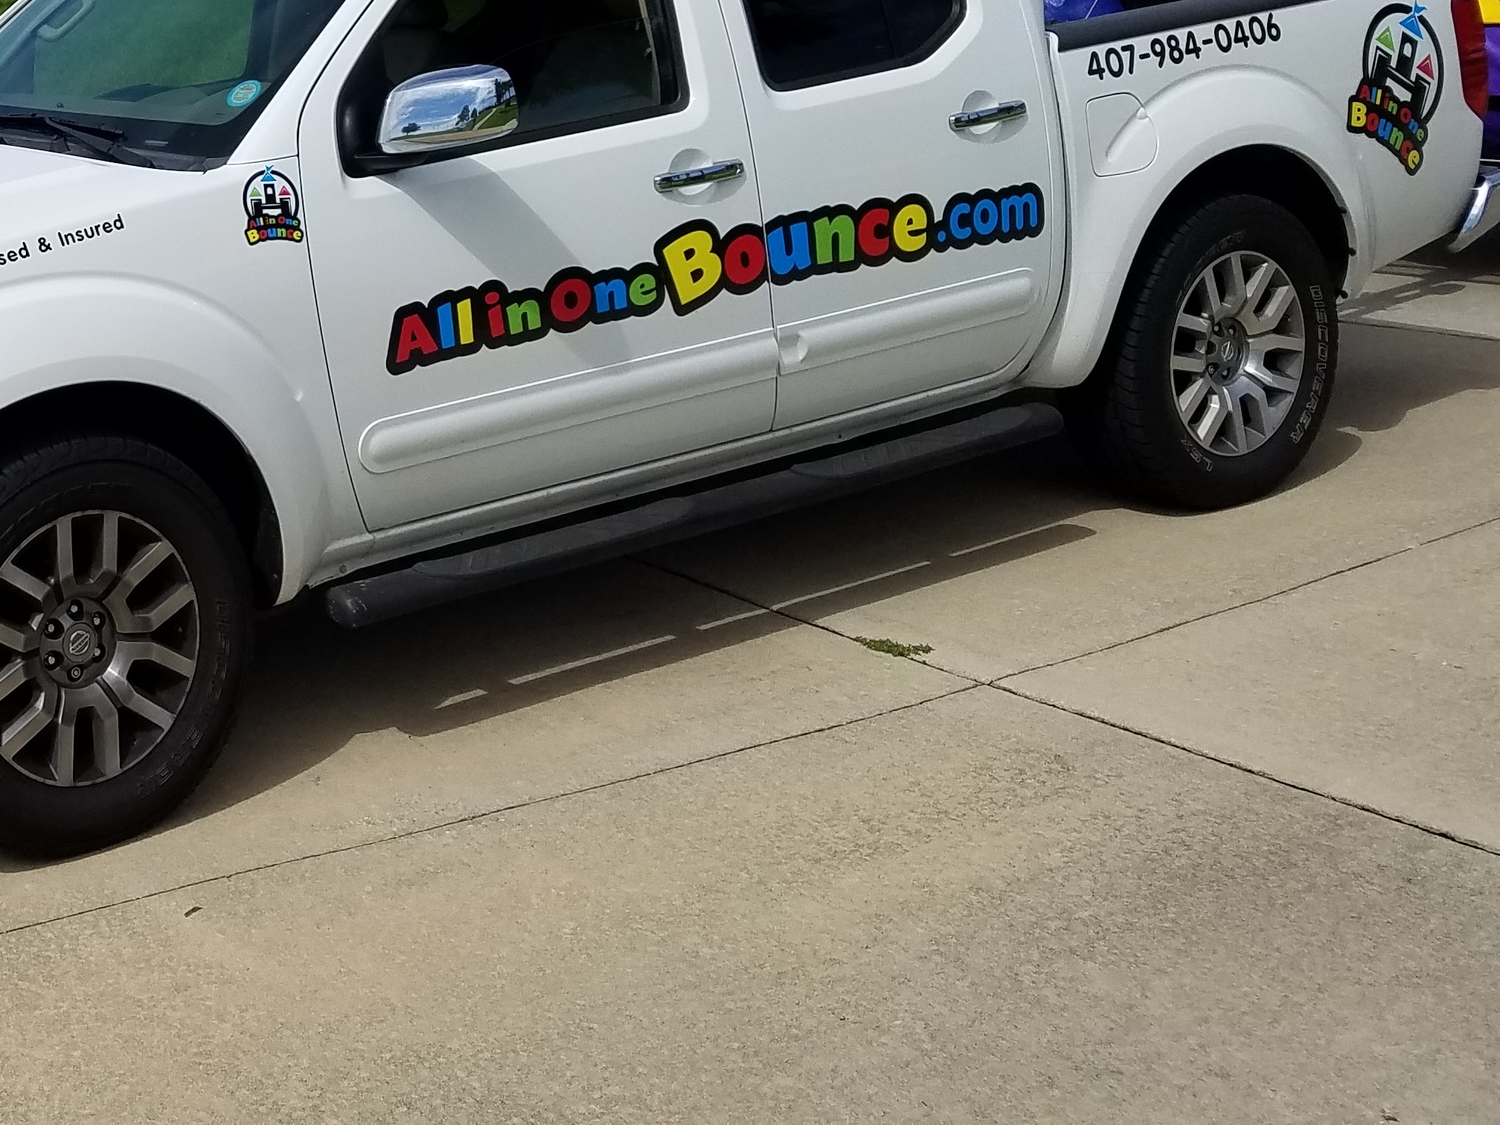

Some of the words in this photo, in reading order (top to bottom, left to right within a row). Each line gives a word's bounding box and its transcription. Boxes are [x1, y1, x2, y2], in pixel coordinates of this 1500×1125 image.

[1087, 12, 1281, 80] 407-984-0406
[1351, 102, 1420, 170] Bounce
[1359, 84, 1382, 105] All
[1383, 93, 1398, 115] in
[1400, 107, 1424, 141] One
[37, 236, 52, 253] &
[58, 213, 125, 246] Insured
[247, 228, 302, 243] Bounce
[249, 217, 264, 228] All
[265, 216, 276, 225] in
[277, 216, 299, 226] One
[1290, 284, 1329, 444] DISCOVERER
